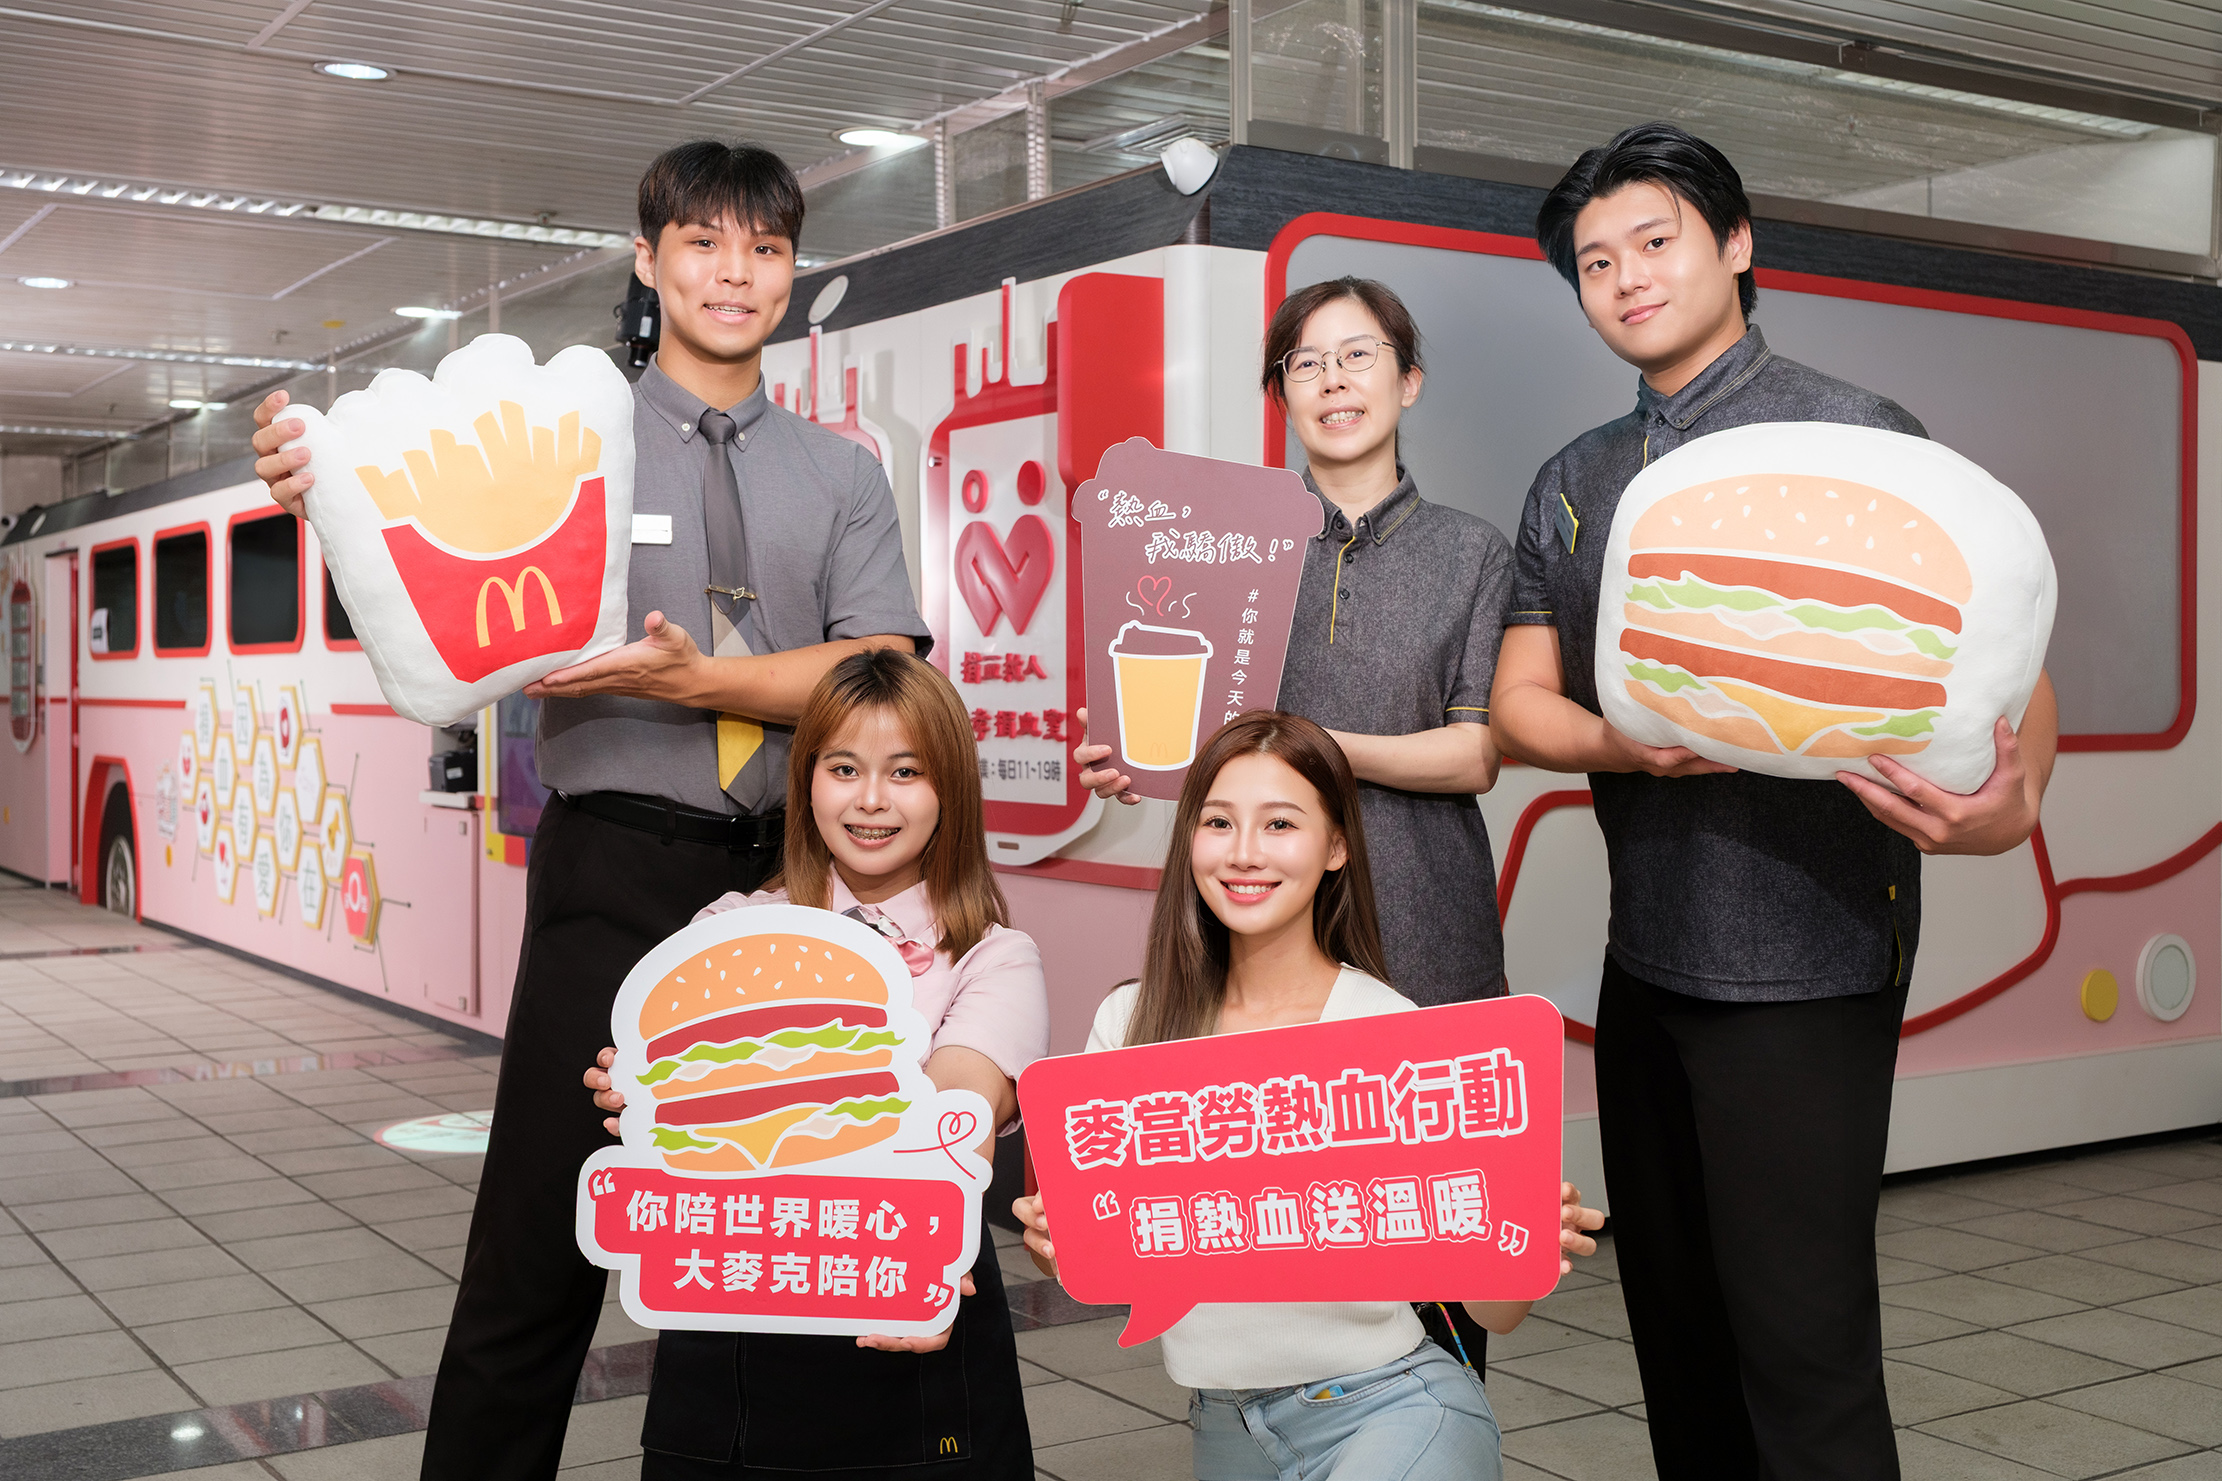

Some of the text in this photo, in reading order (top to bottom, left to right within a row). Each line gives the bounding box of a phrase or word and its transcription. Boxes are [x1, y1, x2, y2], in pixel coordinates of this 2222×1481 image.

[1065, 1048, 1529, 1170] 麥當勞熱血行動
